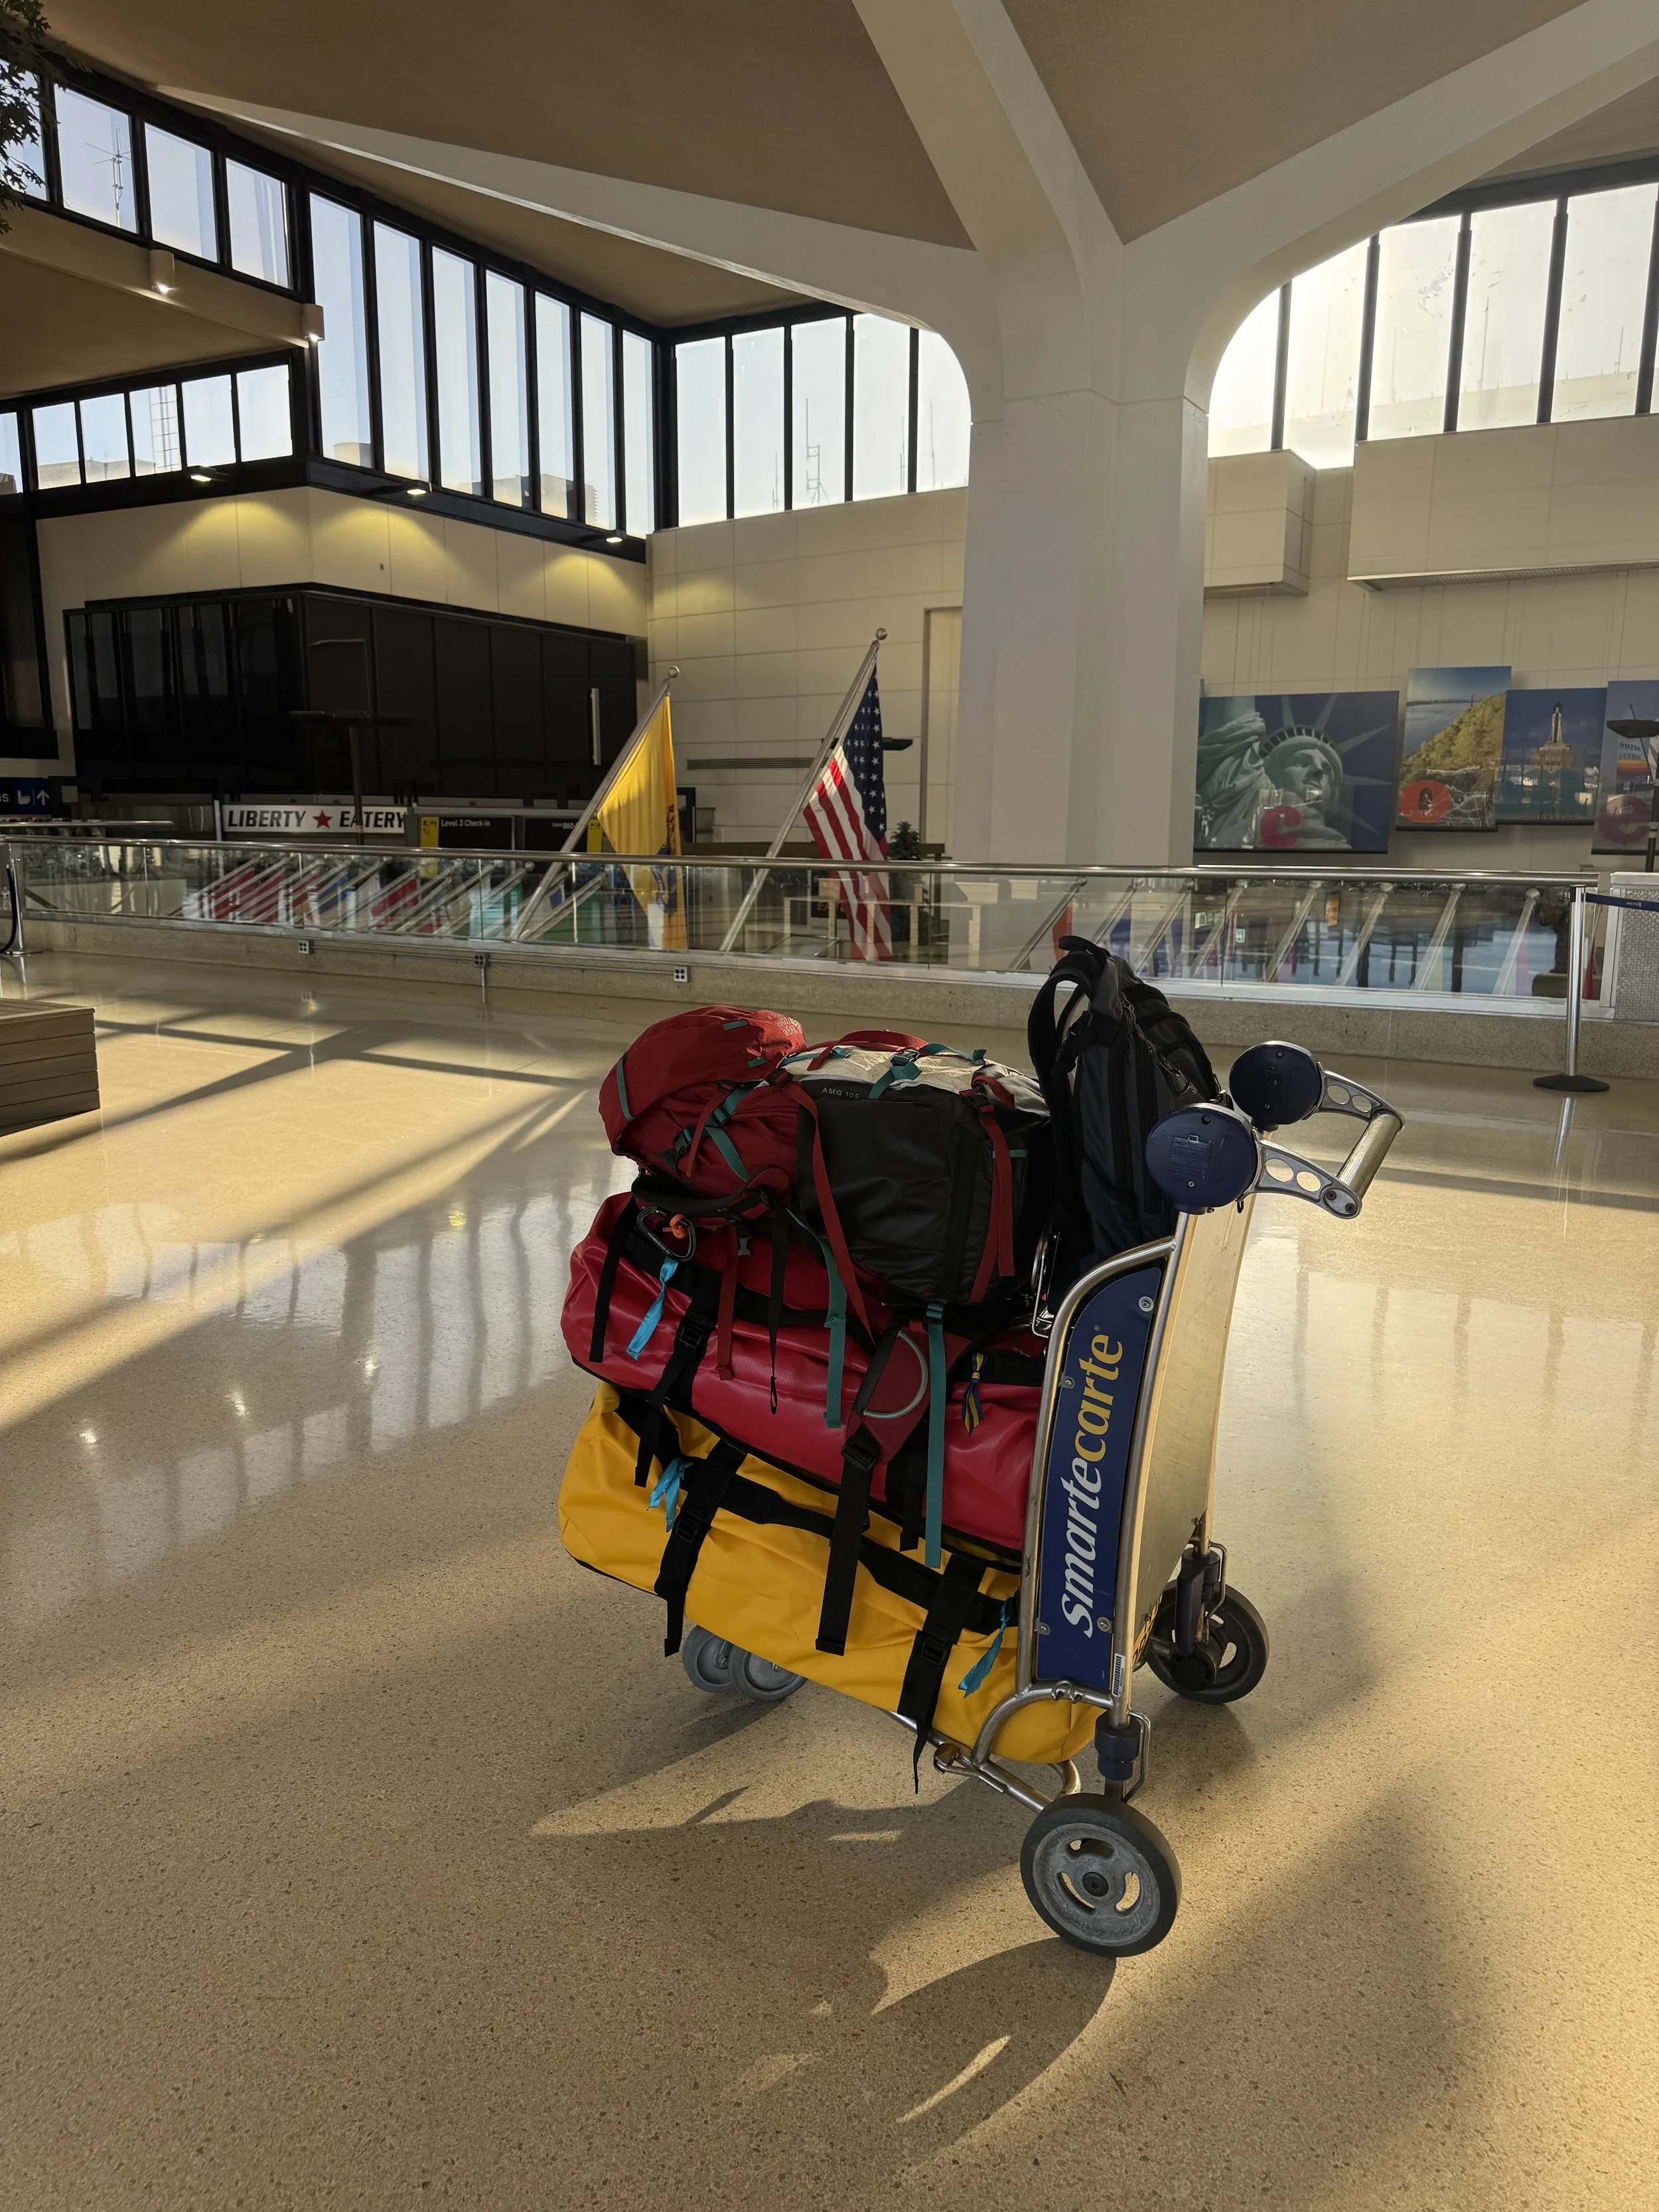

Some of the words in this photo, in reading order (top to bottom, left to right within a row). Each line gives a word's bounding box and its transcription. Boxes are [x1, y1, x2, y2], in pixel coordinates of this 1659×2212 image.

[228, 810, 307, 828] LIBERTY
[441, 818, 458, 828] Level
[459, 819, 464, 828] 3
[464, 819, 491, 828] Check-in
[822, 1086, 842, 1096] AMG
[1060, 1333, 1123, 1639] smartecarte
